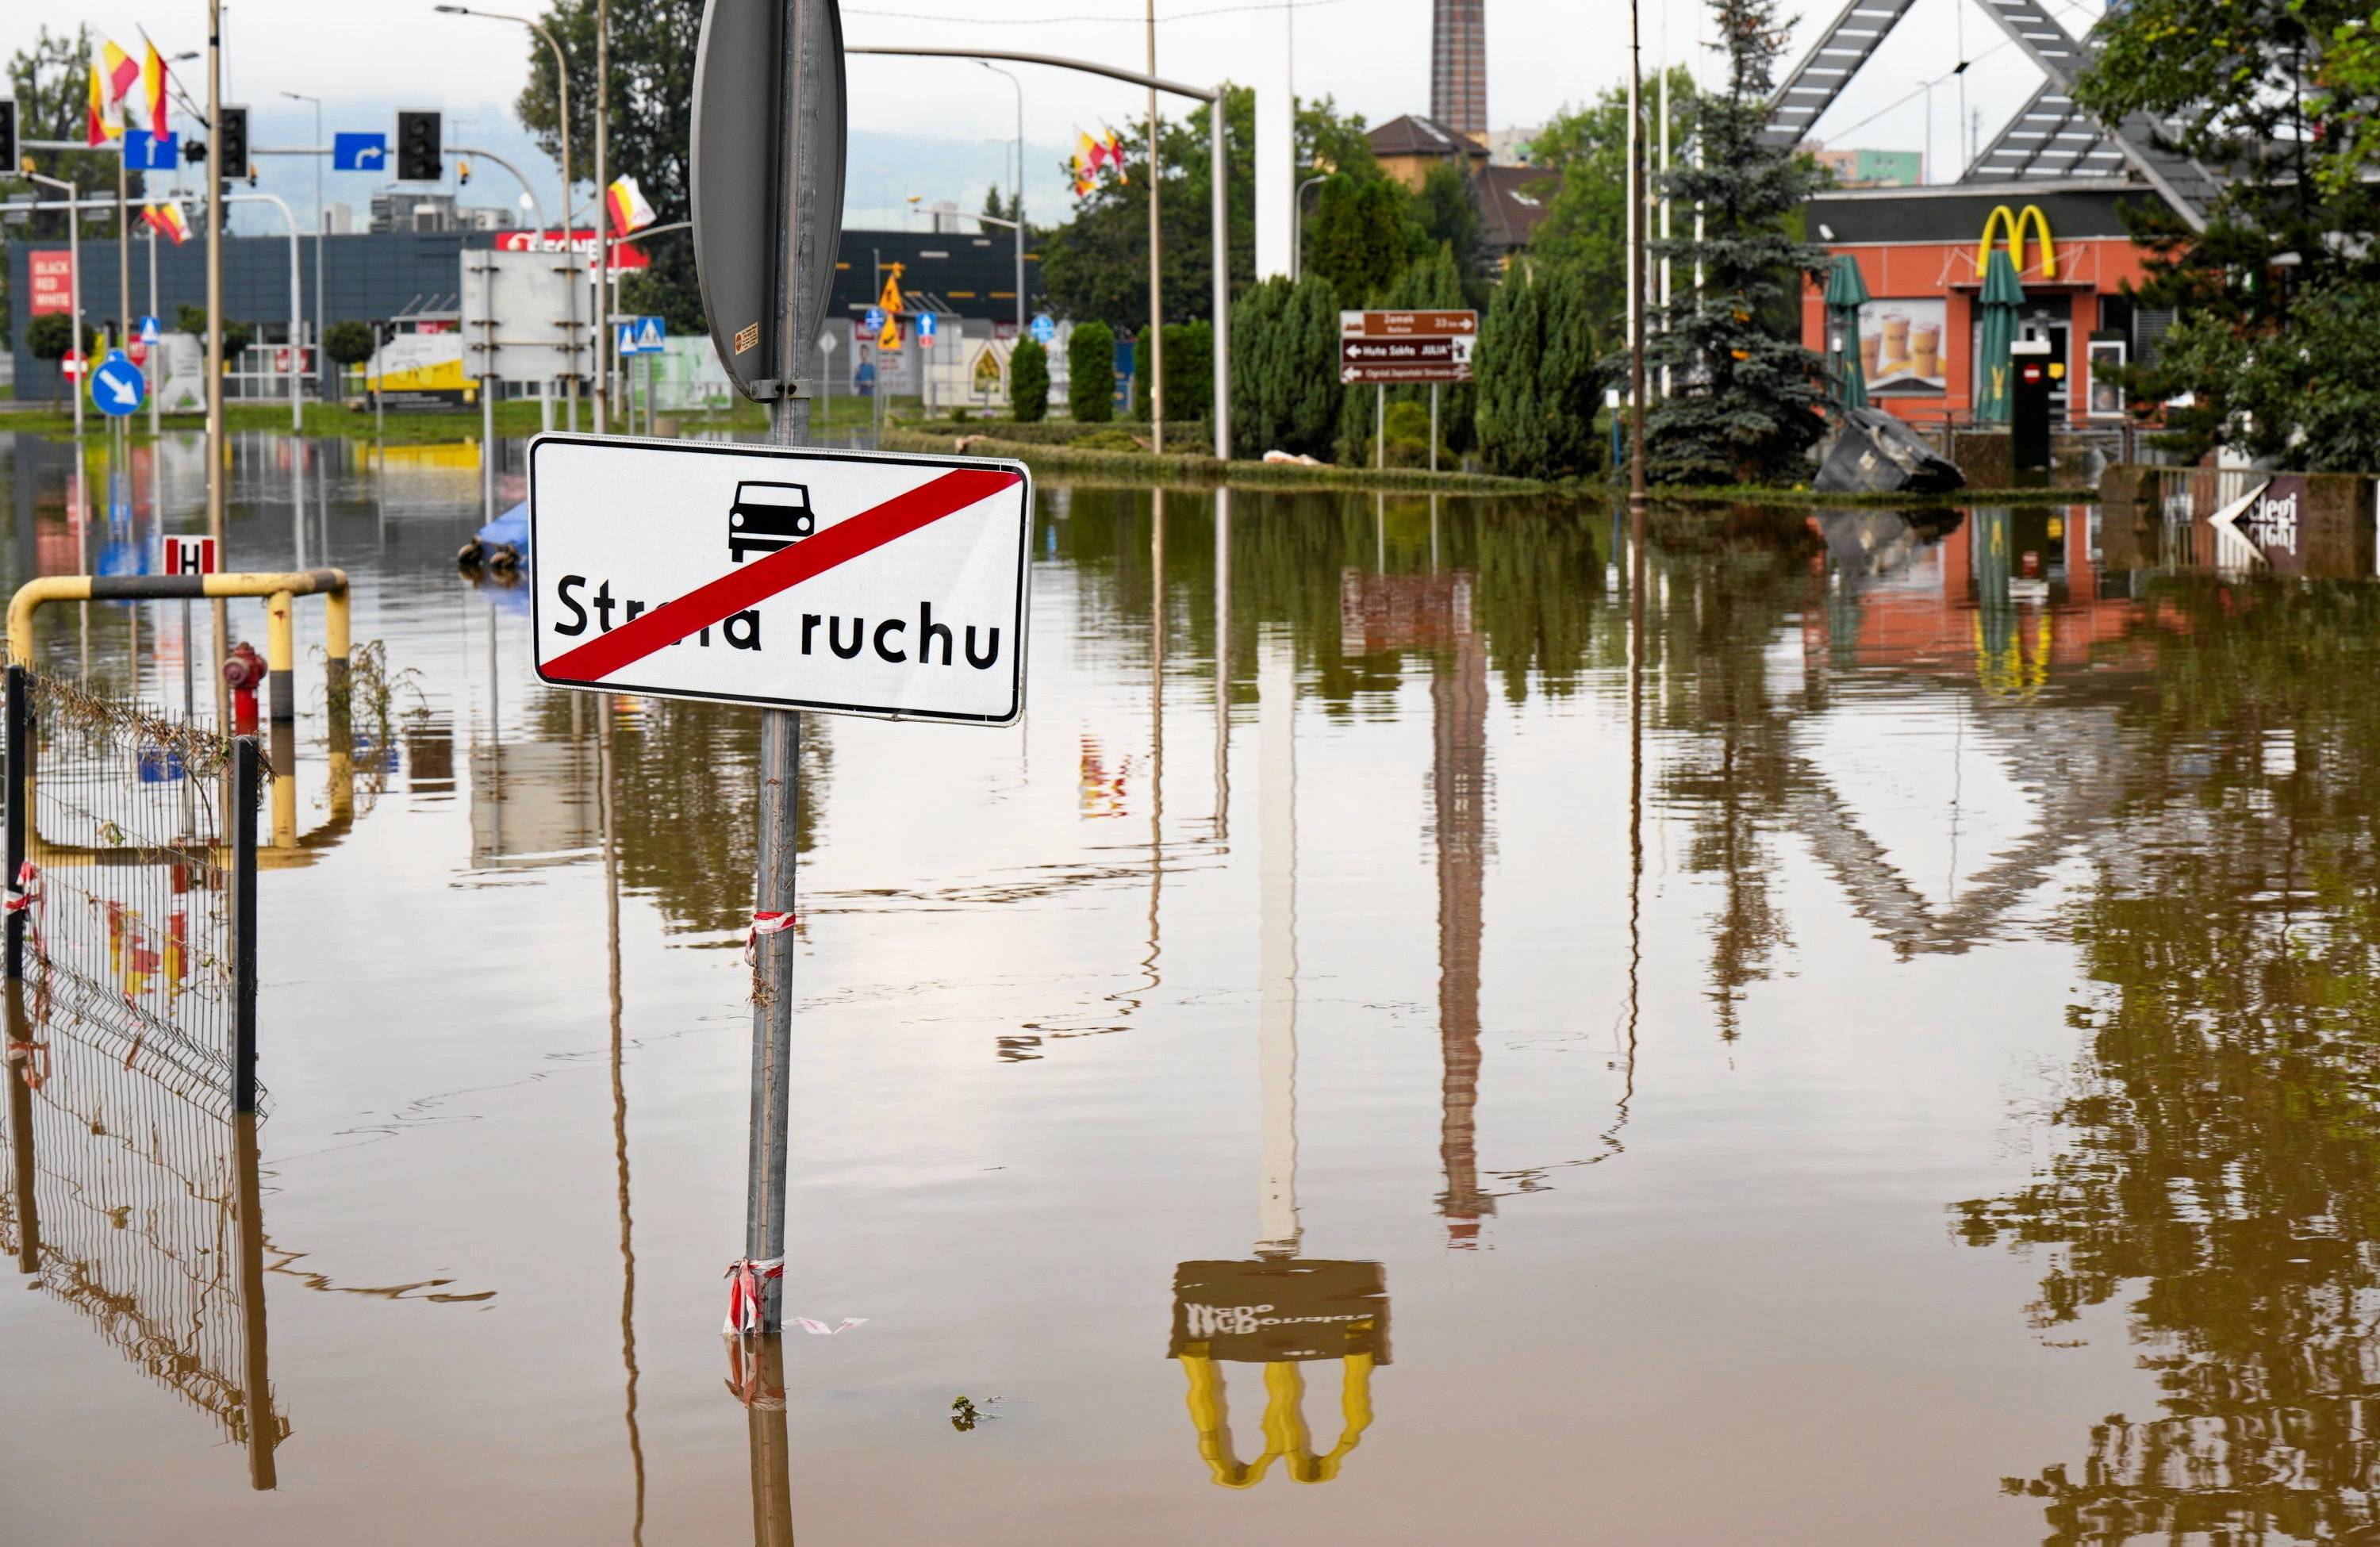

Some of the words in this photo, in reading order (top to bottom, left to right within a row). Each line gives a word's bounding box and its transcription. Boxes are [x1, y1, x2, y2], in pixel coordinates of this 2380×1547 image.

[35, 261, 70, 274] BLACK
[35, 276, 58, 291] RED
[35, 292, 70, 306] WHITE
[181, 545, 199, 574] H
[554, 574, 762, 651] Stra
[801, 601, 1000, 670] ruchu
